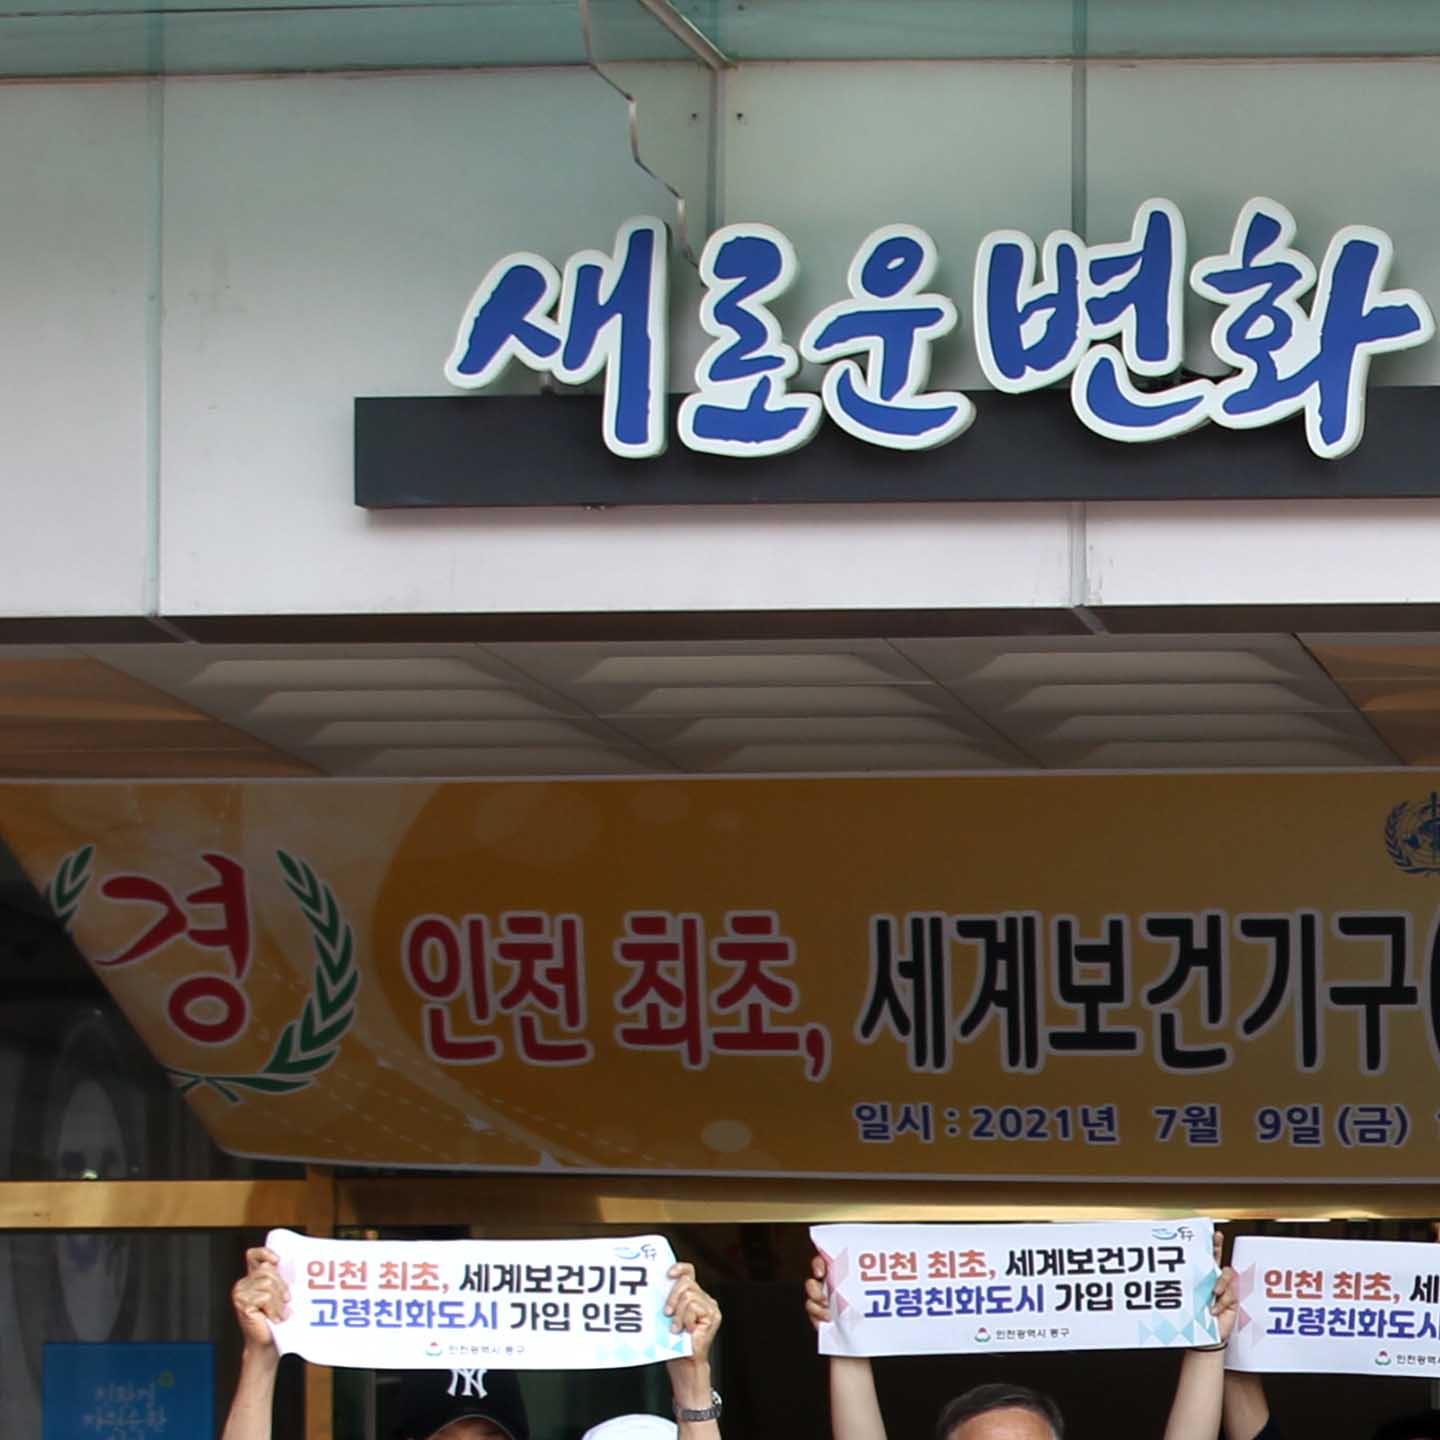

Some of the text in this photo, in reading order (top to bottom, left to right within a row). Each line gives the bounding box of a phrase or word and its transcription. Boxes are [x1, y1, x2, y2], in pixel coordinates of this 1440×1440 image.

[99, 853, 252, 1043] 경
[407, 913, 590, 1063] 인천
[616, 913, 829, 1079] 최초,
[1152, 1104, 1220, 1145] 7월
[307, 1261, 648, 1295] 인천 최초, 세계보건기구
[859, 1246, 1185, 1282] 인천 최초, 세계보건기구
[310, 1299, 642, 1333] 고령친화도시 가입 인증
[864, 1280, 1182, 1318] 고령친화도시 가입 인증
